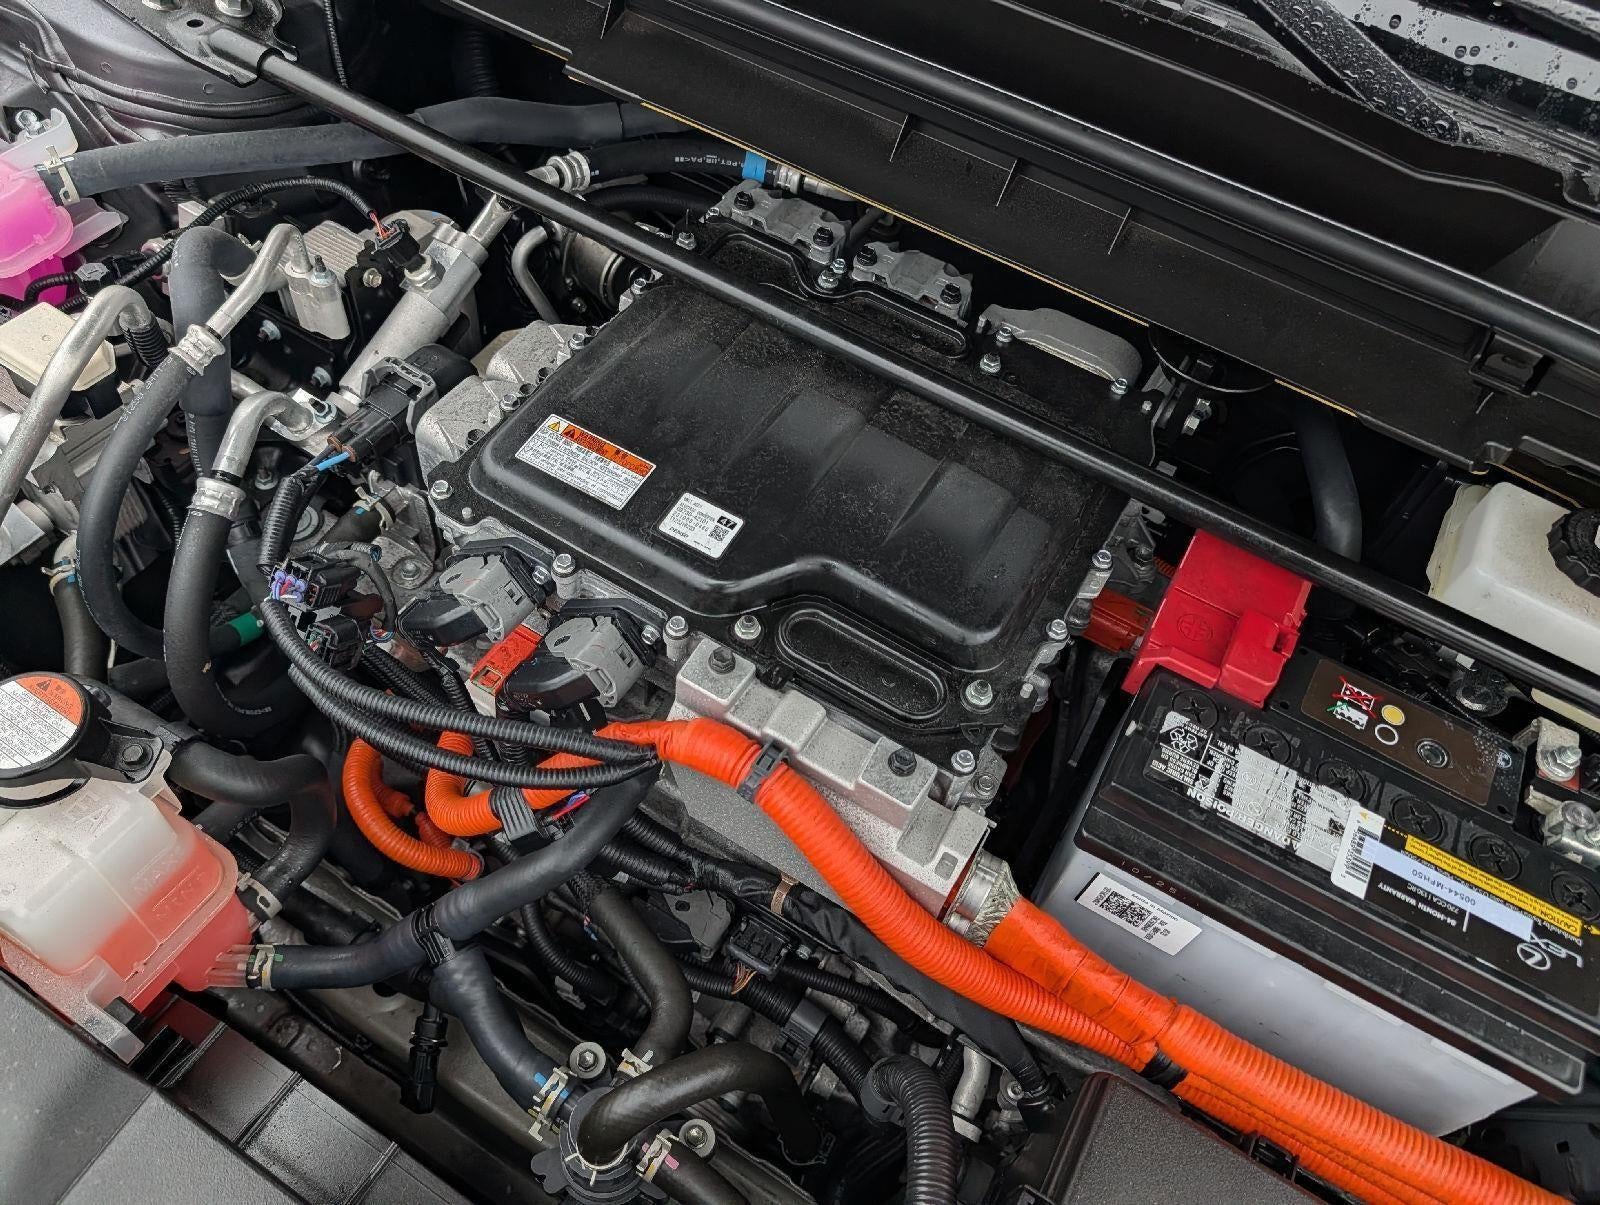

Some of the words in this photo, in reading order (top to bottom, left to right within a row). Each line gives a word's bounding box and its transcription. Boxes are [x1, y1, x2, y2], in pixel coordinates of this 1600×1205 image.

[1165, 766, 1194, 784] SULFURIC
[1184, 785, 1290, 846] DANGER/POISON
[1376, 880, 1417, 905] WARRANTY
